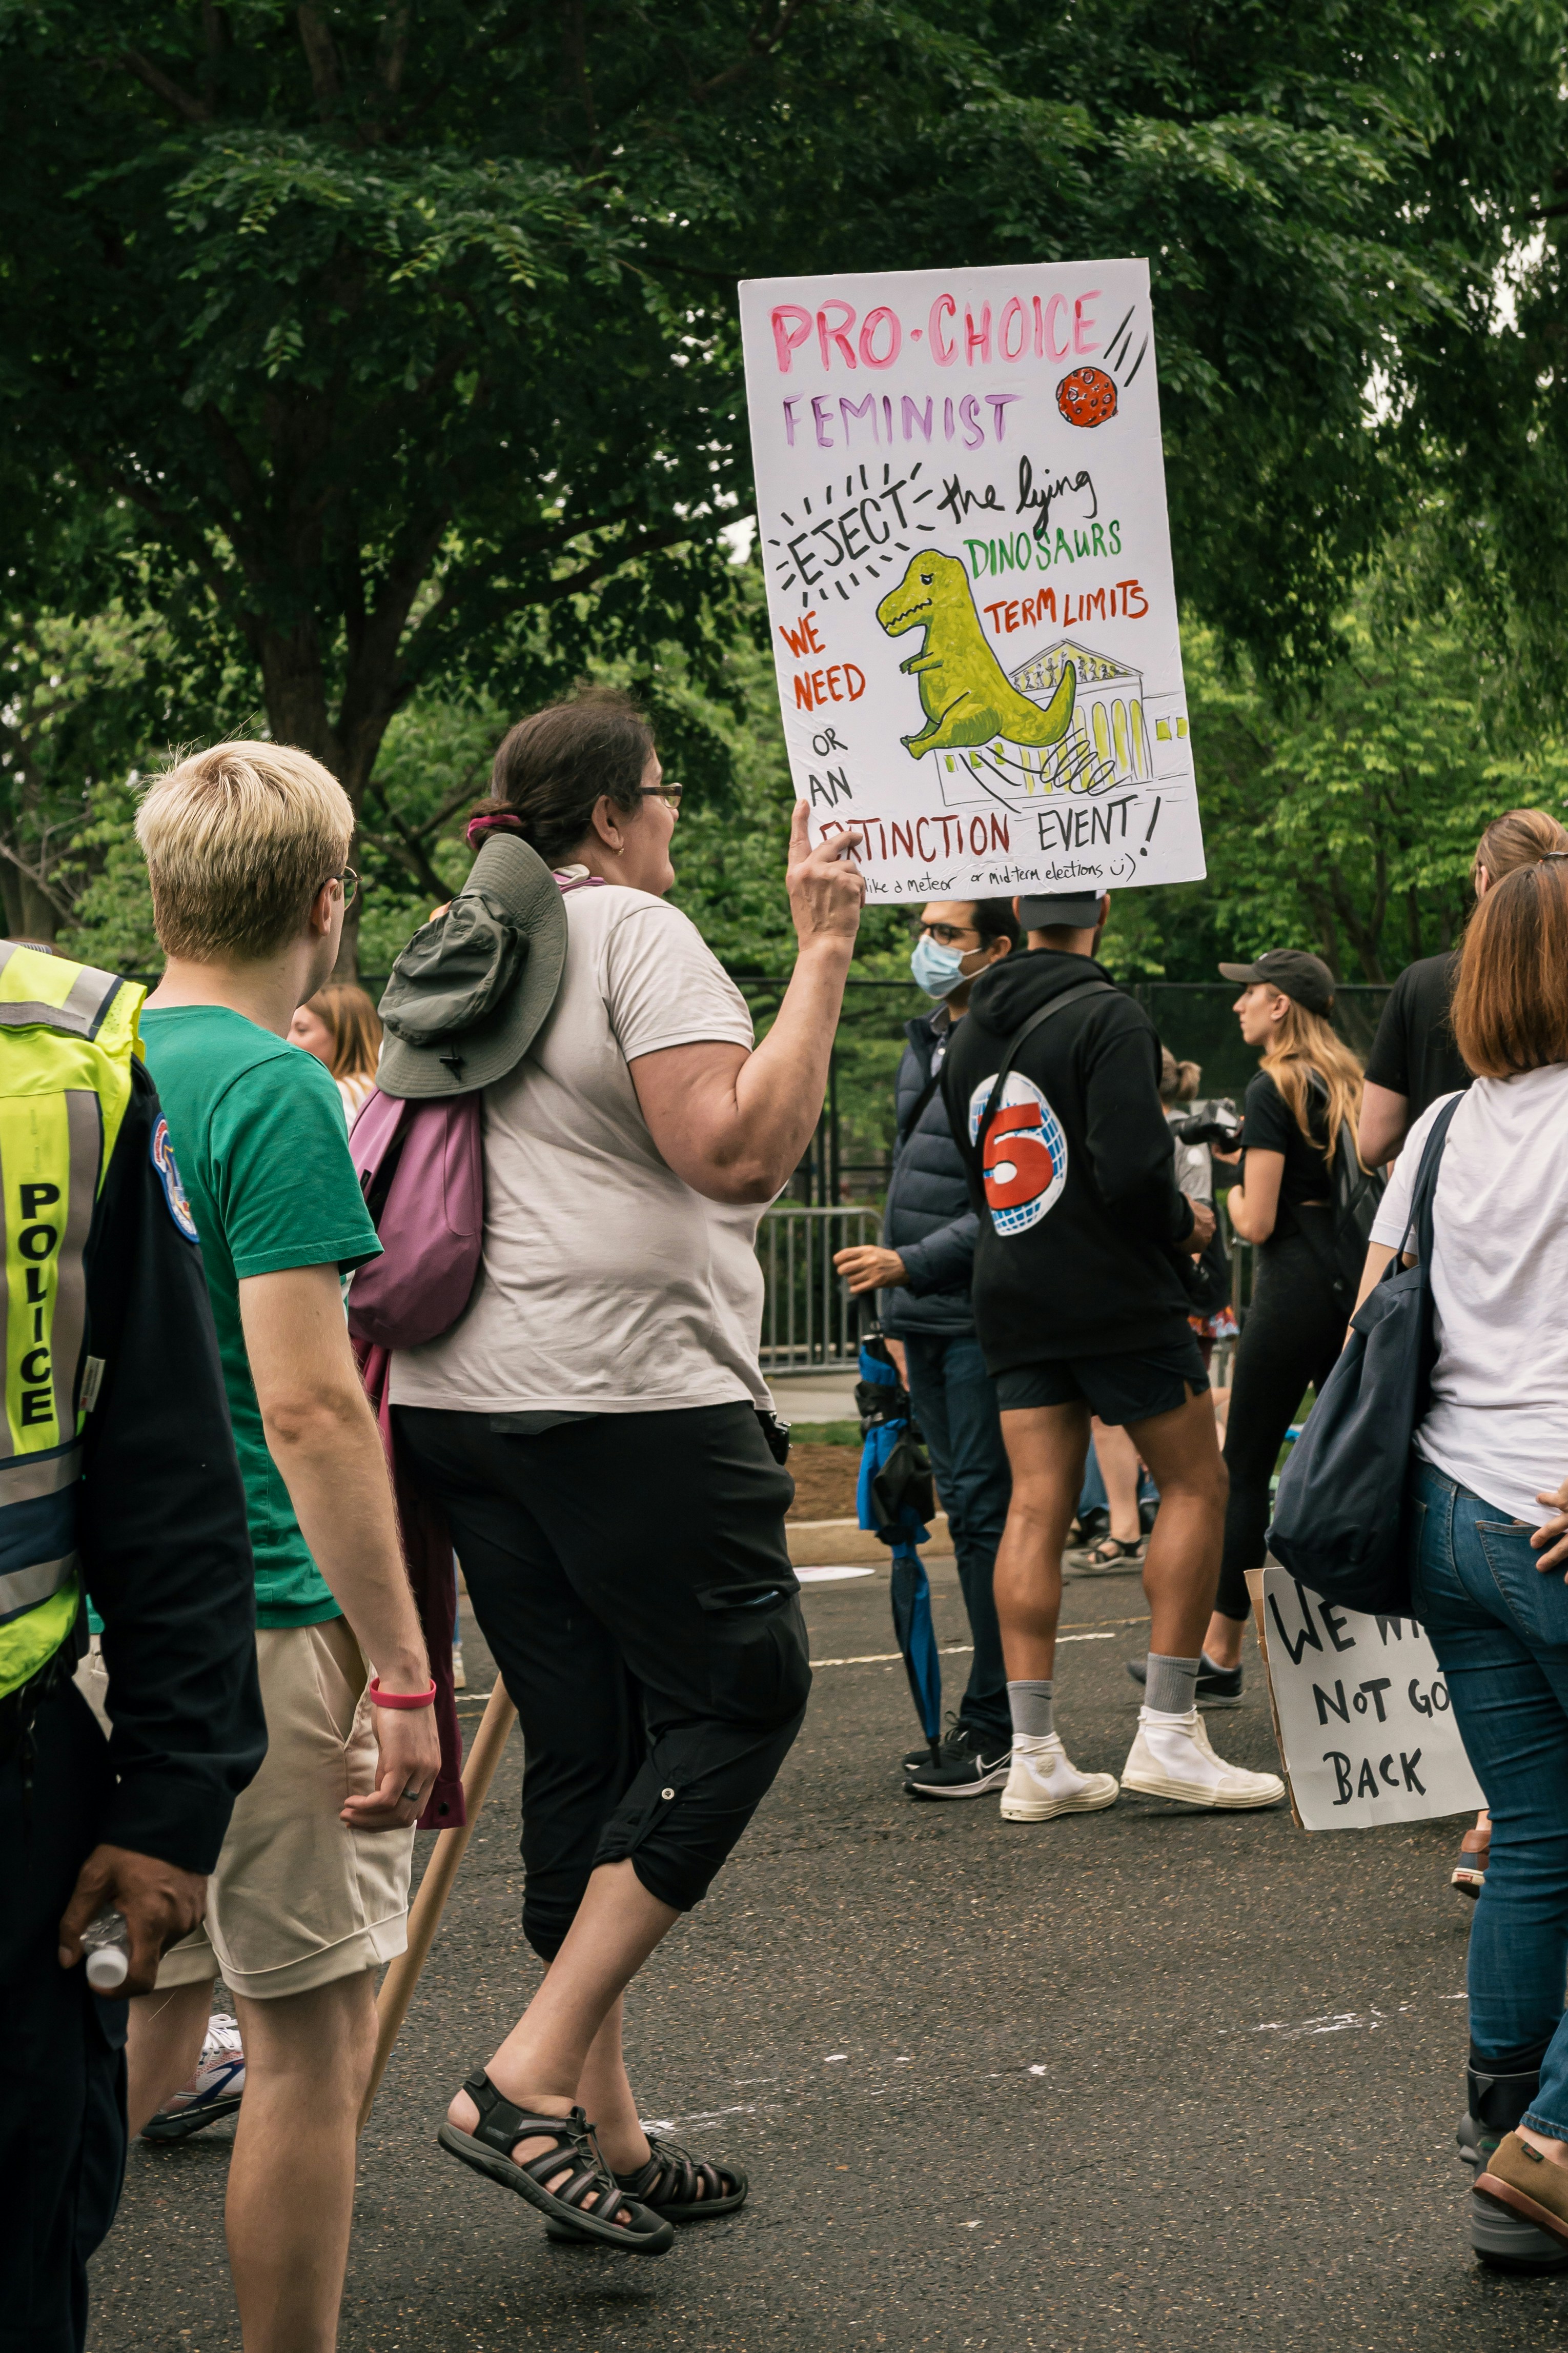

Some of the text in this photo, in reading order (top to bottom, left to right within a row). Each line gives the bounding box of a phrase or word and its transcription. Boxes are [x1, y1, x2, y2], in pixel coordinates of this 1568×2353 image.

[782, 392, 1023, 450] FEMINIST
[787, 455, 1097, 585] EJECT the lying
[962, 519, 1122, 579] DINOSAURS
[779, 610, 826, 658] WE
[983, 579, 1149, 634] TERM LIMITS
[793, 663, 866, 712] NEED
[812, 728, 848, 757] OR
[808, 766, 853, 809] AN
[971, 872, 984, 882] or
[1046, 859, 1103, 880] elections
[976, 1101, 1054, 1211] 5
[18, 1182, 60, 1427] POLICE
[1268, 1579, 1356, 1665] WE
[1408, 1678, 1450, 1718] GO
[1322, 1747, 1426, 1805] BACK
